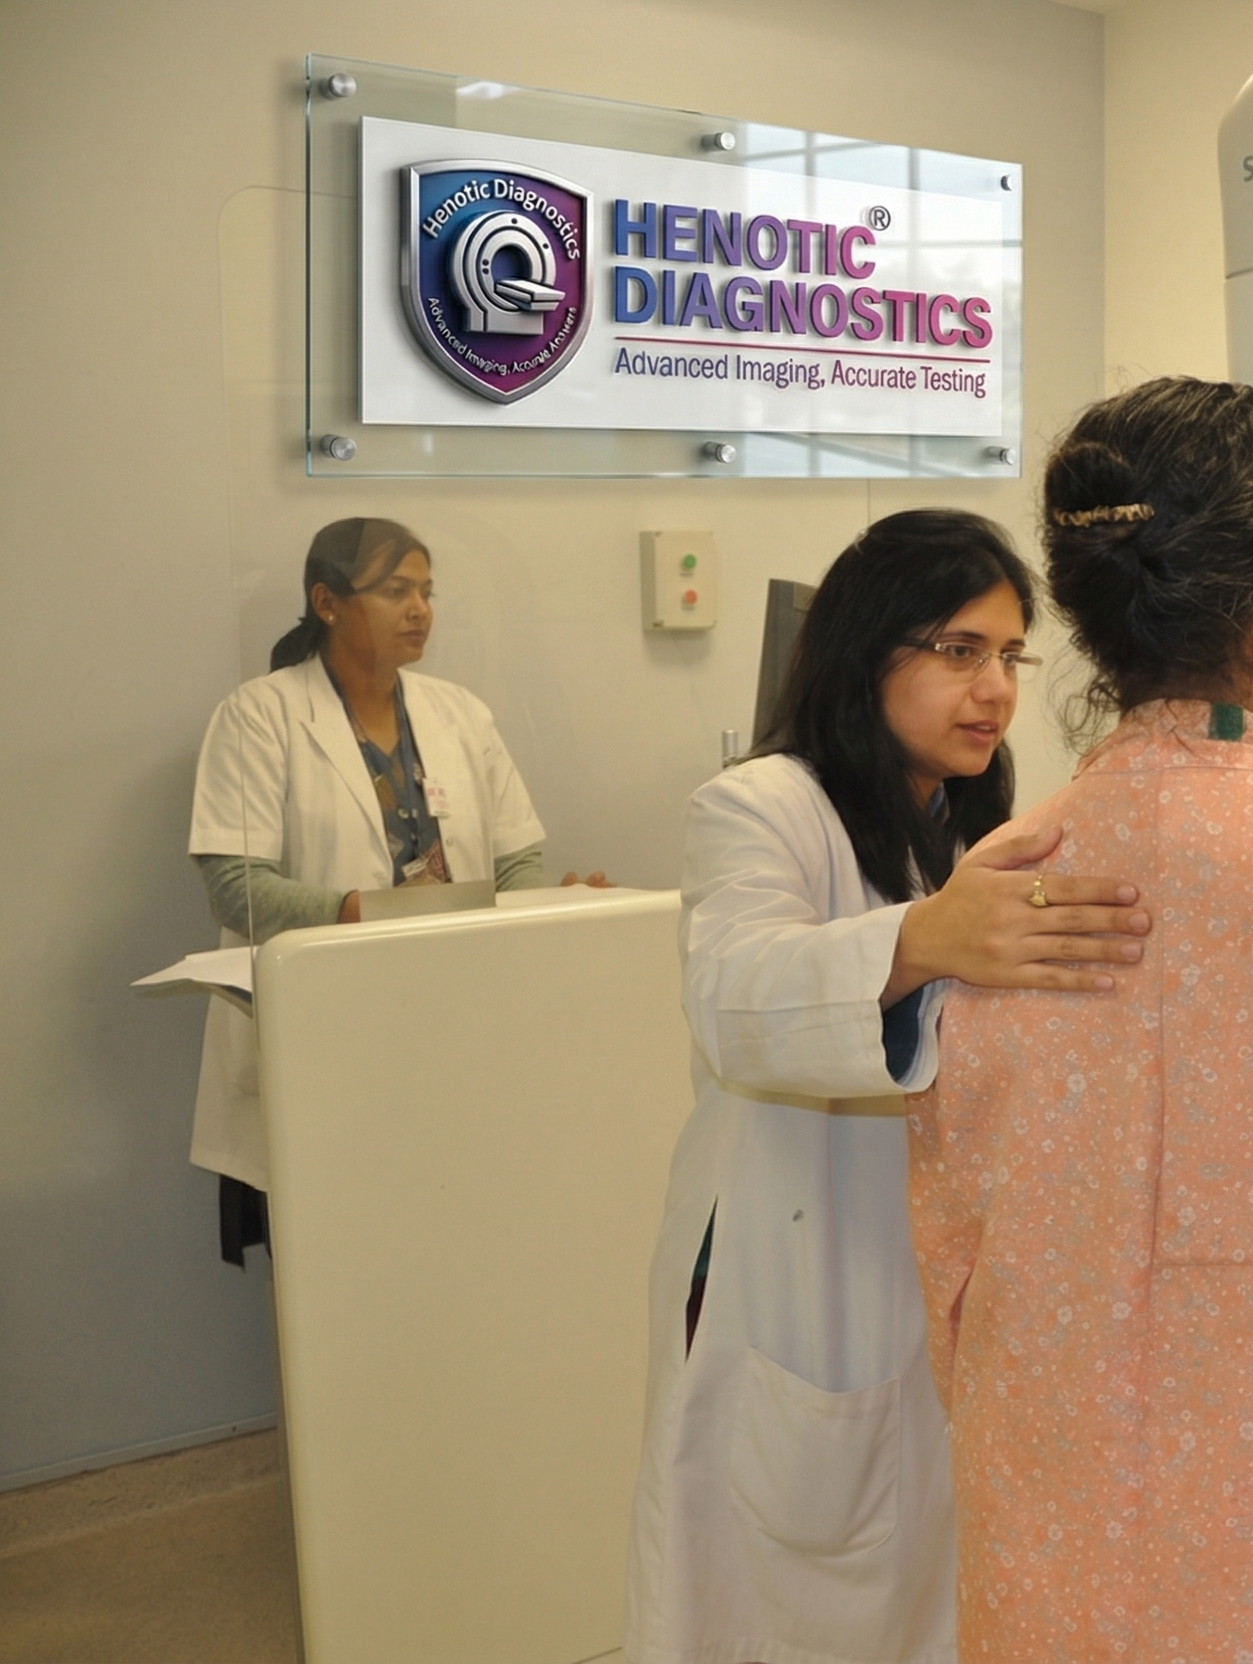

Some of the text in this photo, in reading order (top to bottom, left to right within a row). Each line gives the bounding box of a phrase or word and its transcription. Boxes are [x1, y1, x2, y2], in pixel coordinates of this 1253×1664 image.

[422, 178, 581, 261] Henotic Diagnostics
[613, 265, 994, 349] DIAGNOSTICS
[614, 346, 987, 399] Advanced Imaging, Accurate Testing
